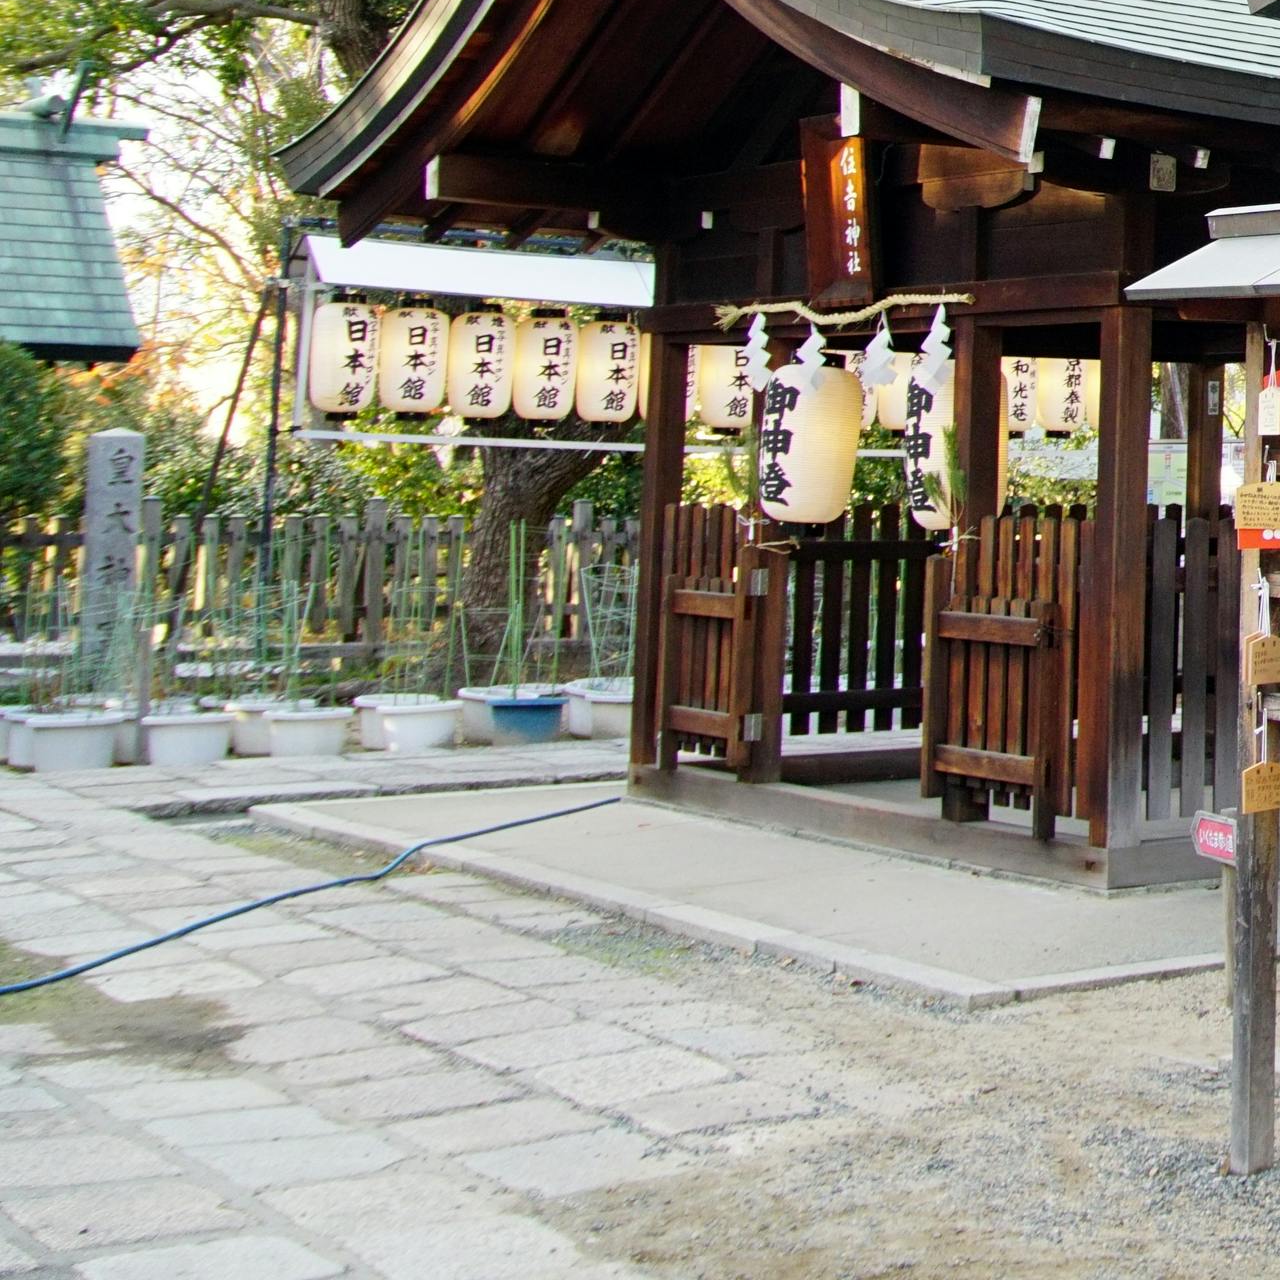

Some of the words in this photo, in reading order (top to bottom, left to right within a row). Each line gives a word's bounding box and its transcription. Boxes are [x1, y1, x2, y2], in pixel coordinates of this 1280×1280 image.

[840, 147, 861, 275] 住吉神社
[337, 320, 368, 406] 日本館
[397, 326, 427, 400] 日本館
[465, 334, 496, 407] 日本館
[531, 337, 563, 409] 日本館
[600, 341, 629, 411] 日本館
